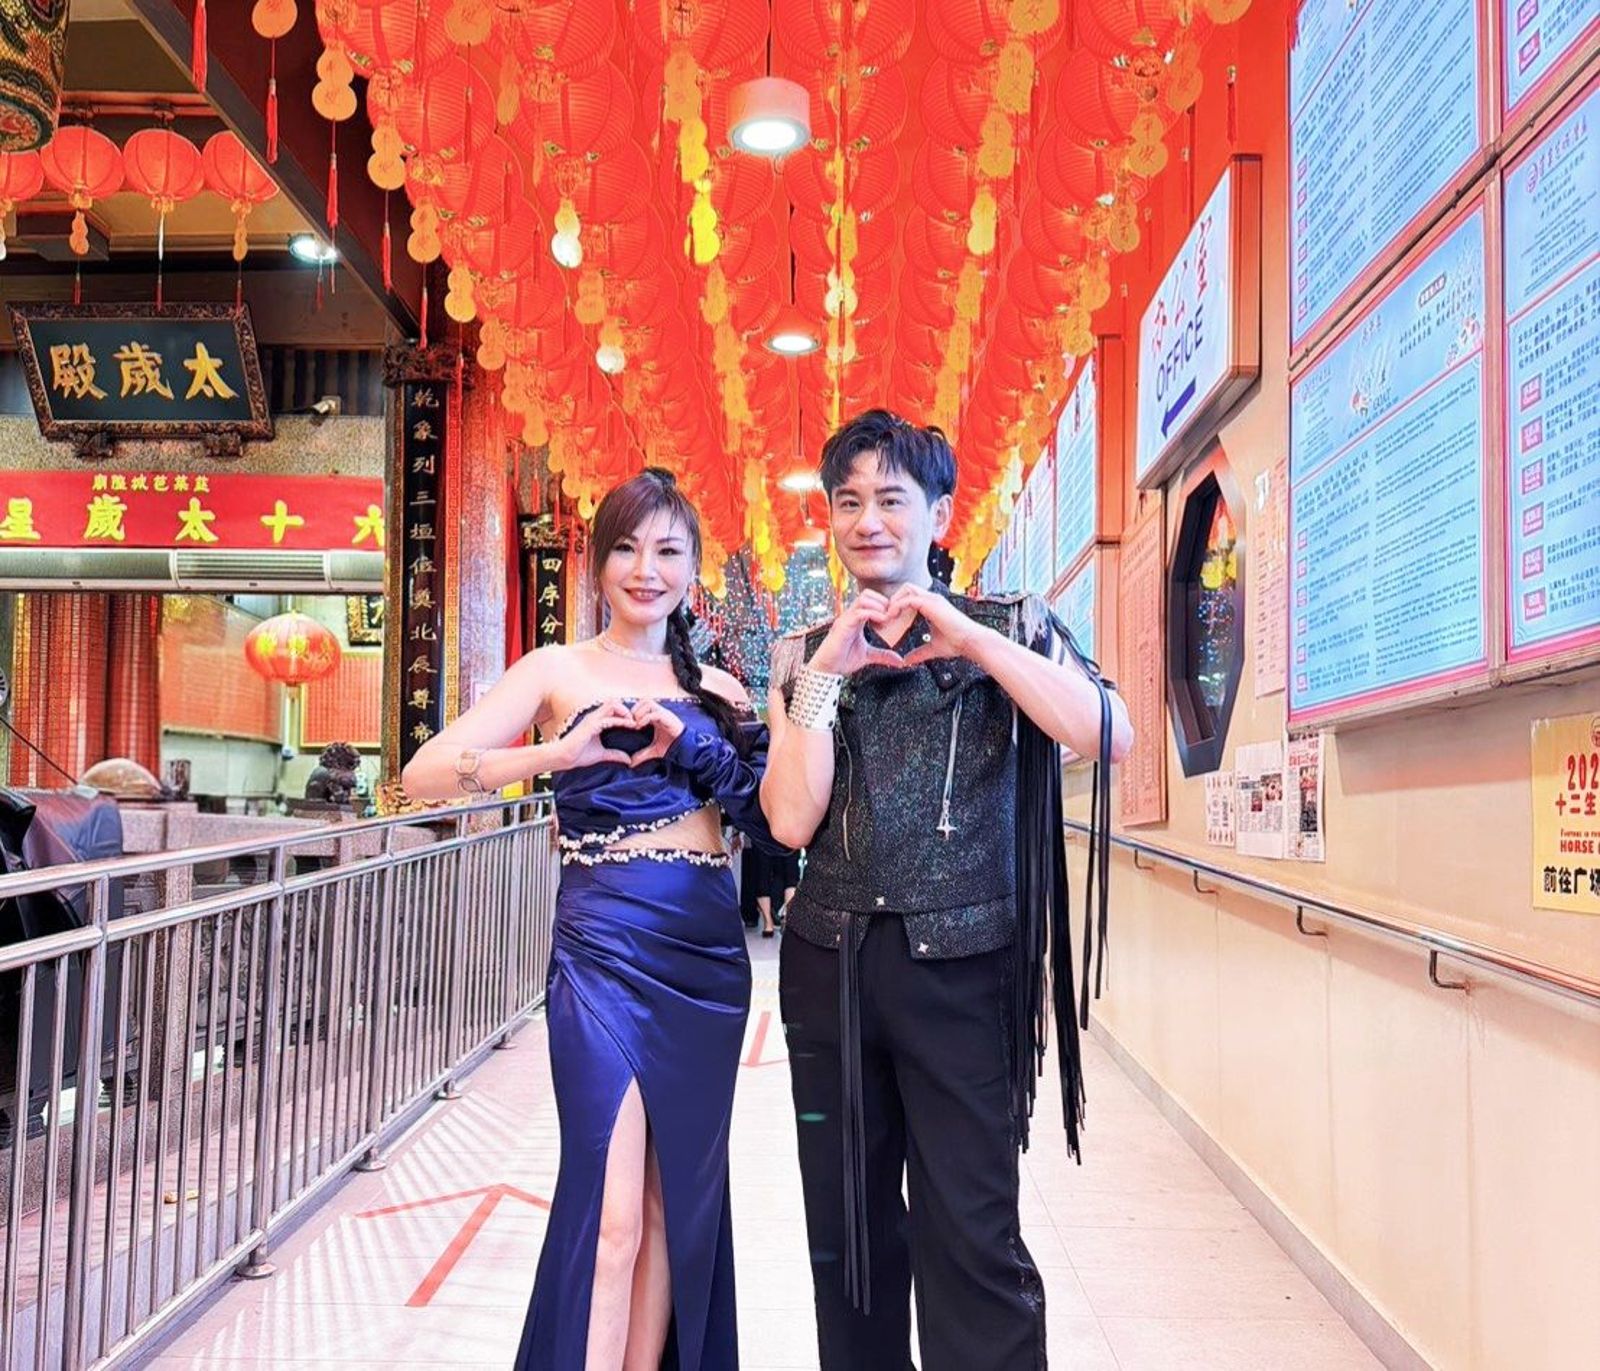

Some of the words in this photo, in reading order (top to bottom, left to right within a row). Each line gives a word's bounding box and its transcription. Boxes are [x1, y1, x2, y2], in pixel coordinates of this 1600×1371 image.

[1156, 304, 1204, 402] OFFICE
[537, 557, 564, 647] 四序分
[1555, 791, 1597, 816] 十二生
[1560, 839, 1594, 854] HORSE
